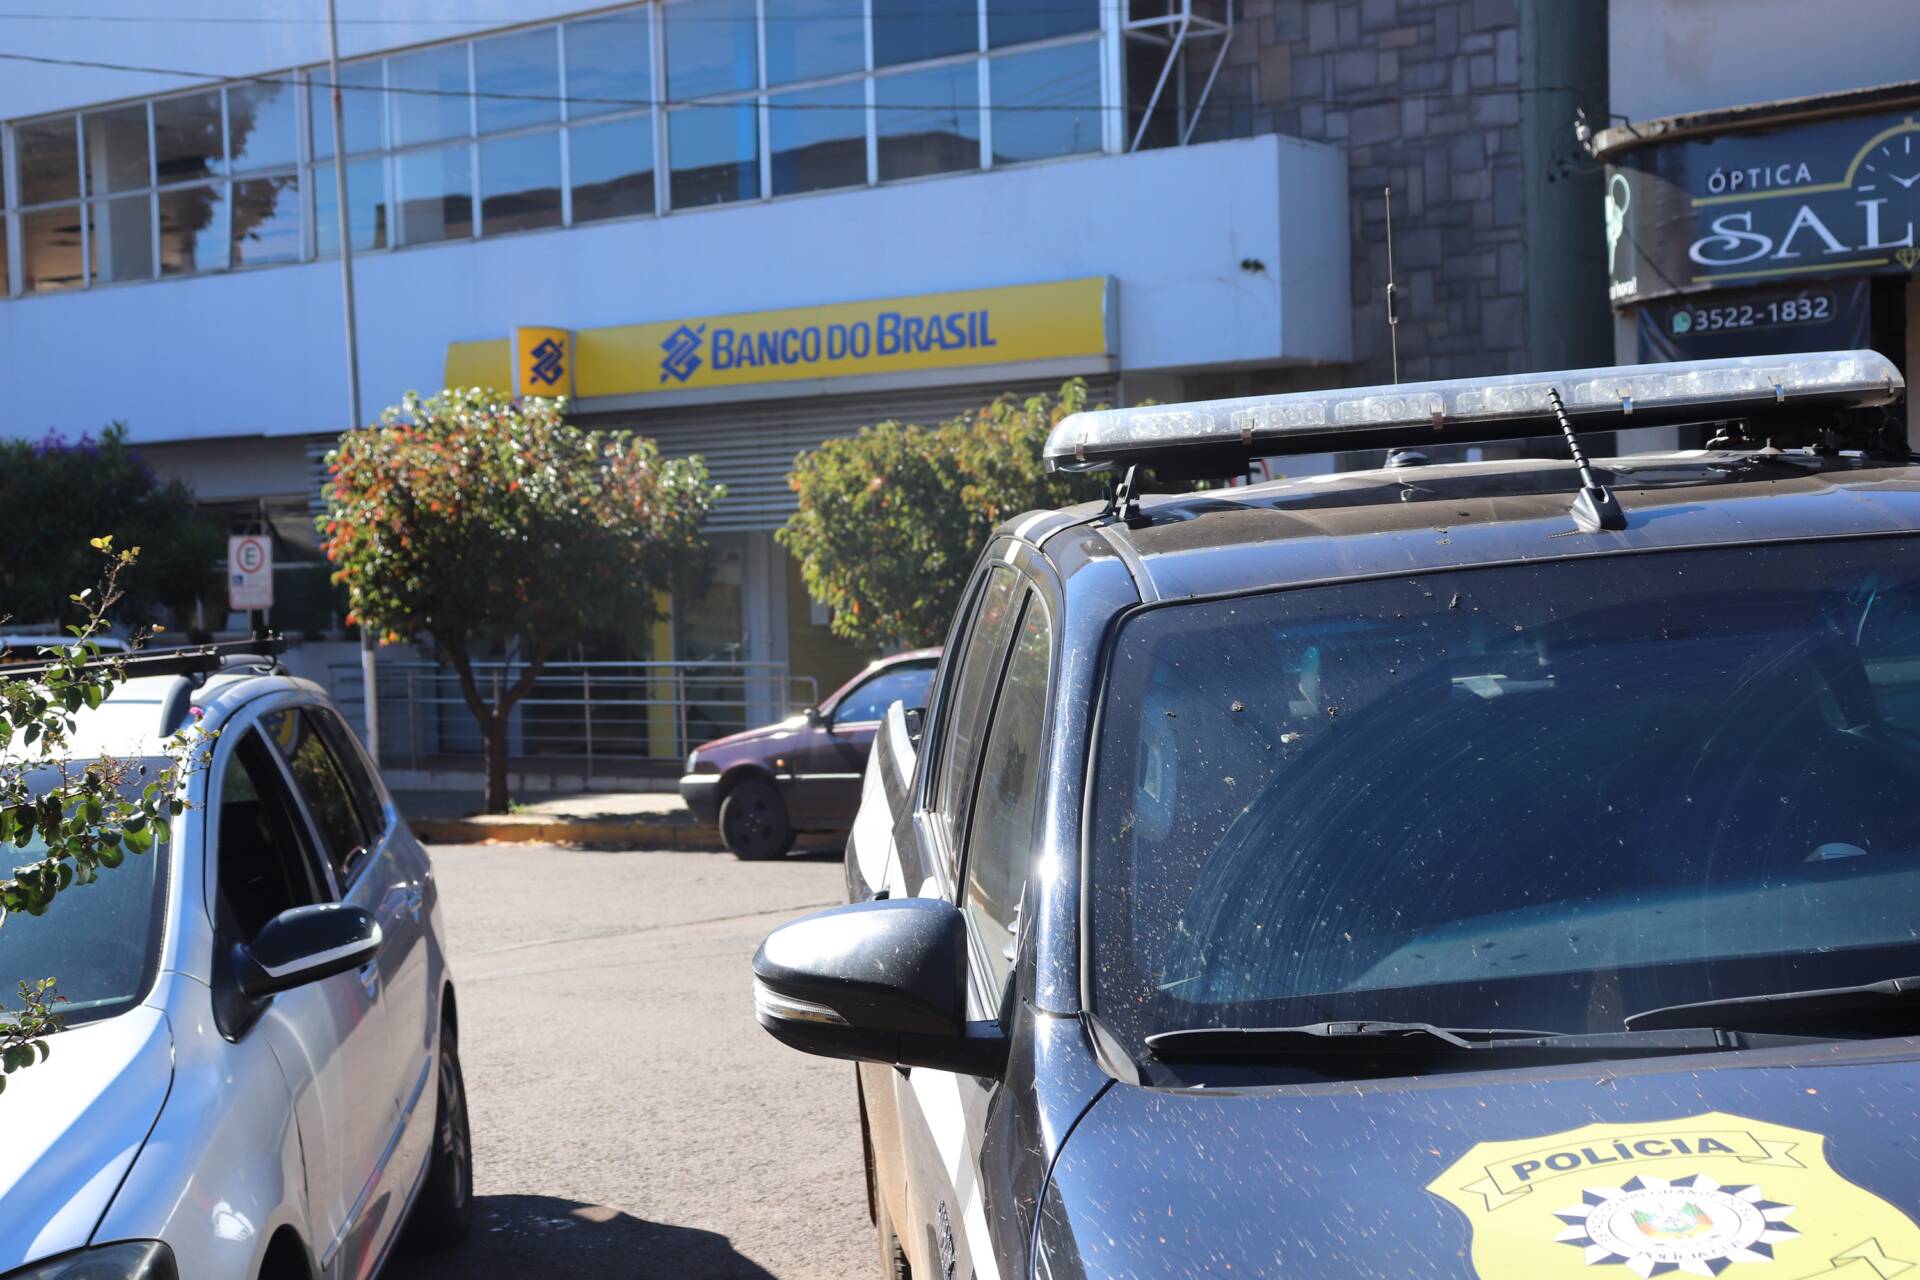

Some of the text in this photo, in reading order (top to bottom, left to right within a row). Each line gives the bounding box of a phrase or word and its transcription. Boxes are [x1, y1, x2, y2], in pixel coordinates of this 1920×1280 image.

[1707, 162, 1812, 193] ÓPTICA
[1695, 297, 1829, 331] 3522-1832
[711, 310, 997, 370] BANCO DO BRASIL
[244, 547, 257, 566] E
[1511, 1137, 1738, 1181] POLÍCIA
